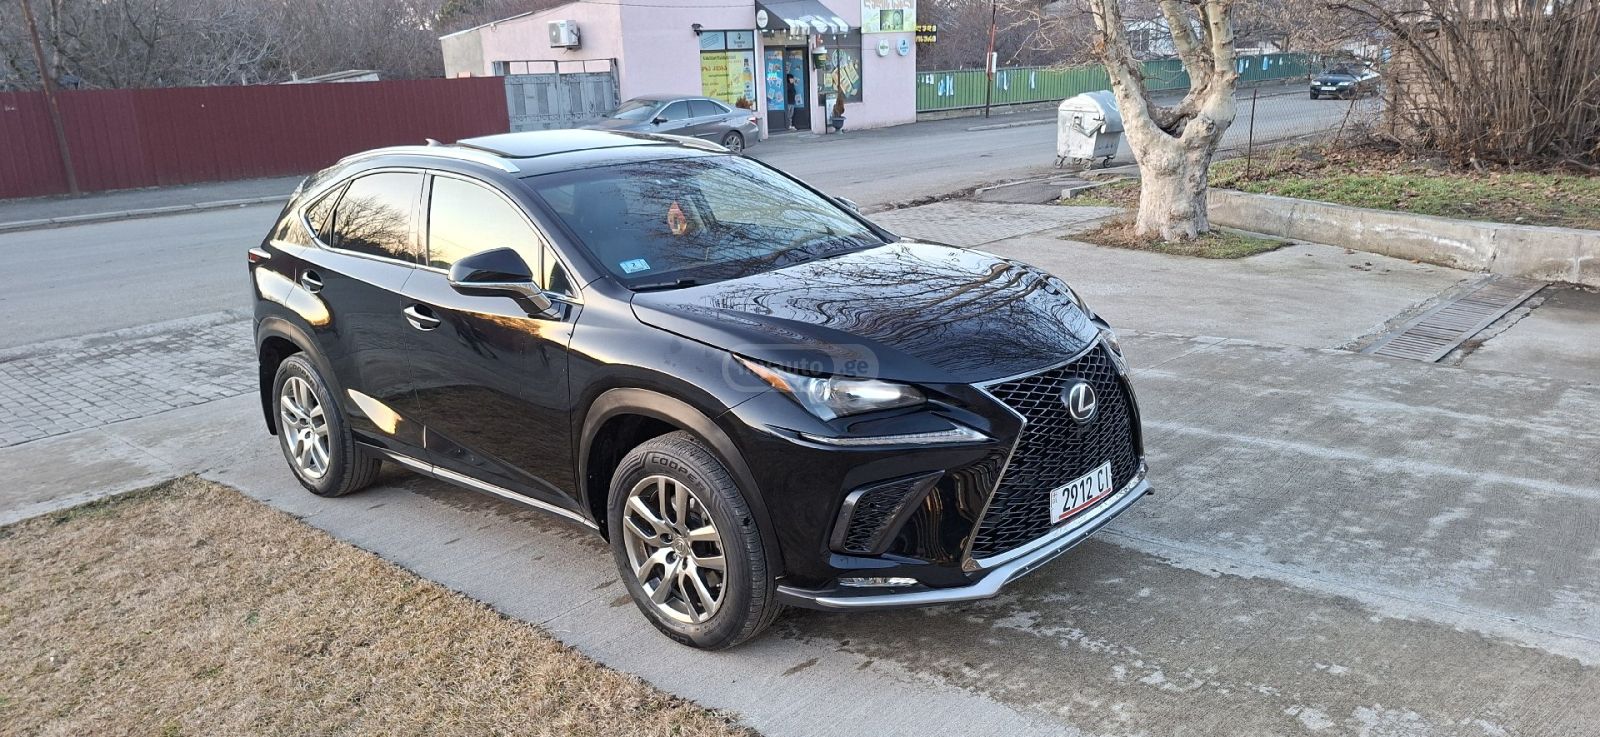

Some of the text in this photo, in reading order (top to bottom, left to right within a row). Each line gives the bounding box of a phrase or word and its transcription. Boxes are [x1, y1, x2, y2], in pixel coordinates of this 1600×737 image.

[651, 456, 707, 491] COOPER
[1062, 465, 1109, 513] 2912 CI
